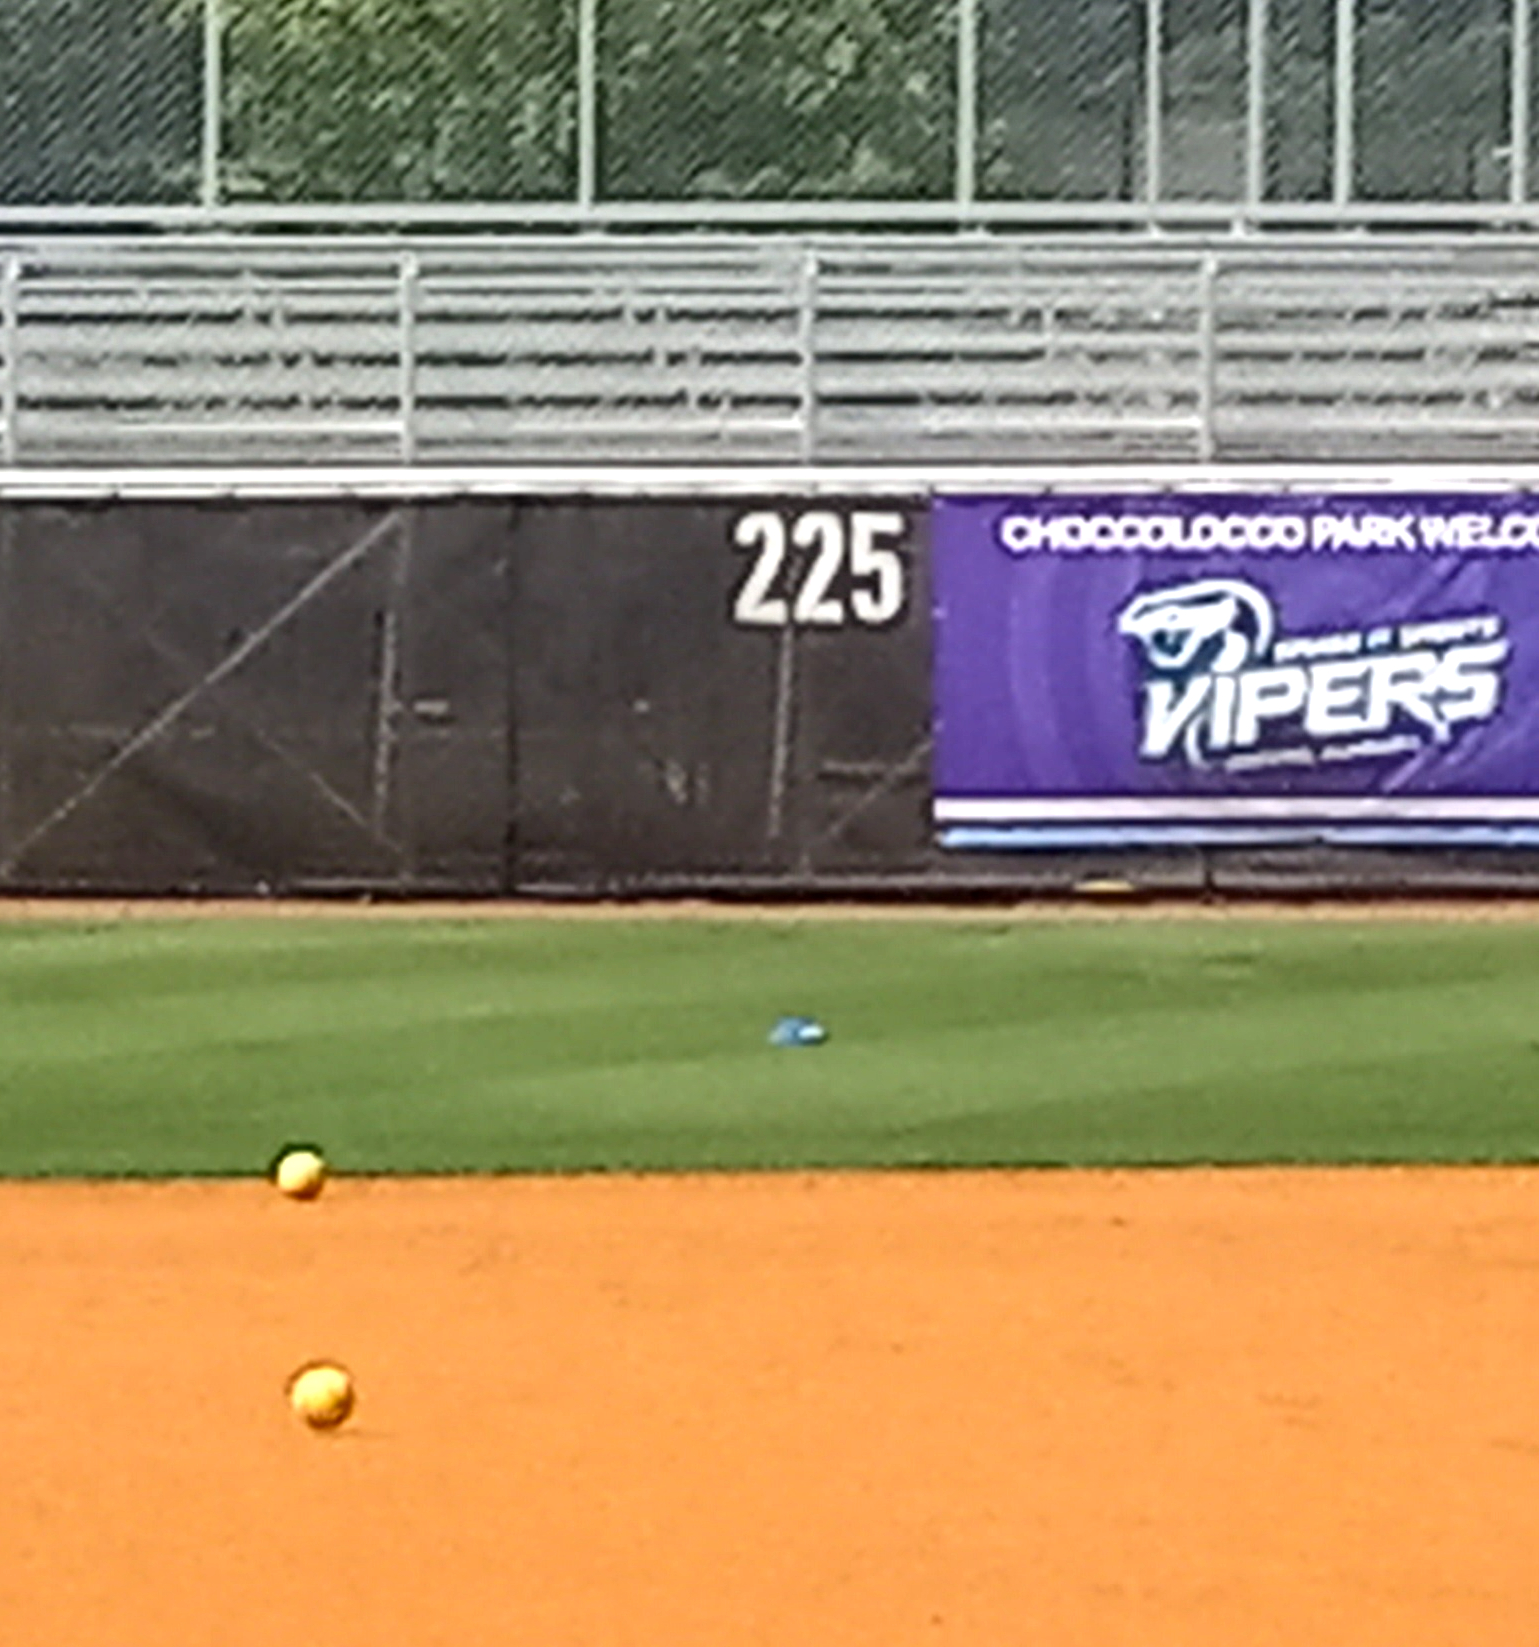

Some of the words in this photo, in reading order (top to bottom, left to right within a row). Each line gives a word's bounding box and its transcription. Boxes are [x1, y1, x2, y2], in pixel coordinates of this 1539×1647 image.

[733, 510, 905, 624] 225
[1002, 513, 1306, 551] CHOCCOLOCCO
[1313, 513, 1415, 551] PARK
[1139, 638, 1508, 758] VIPERS
